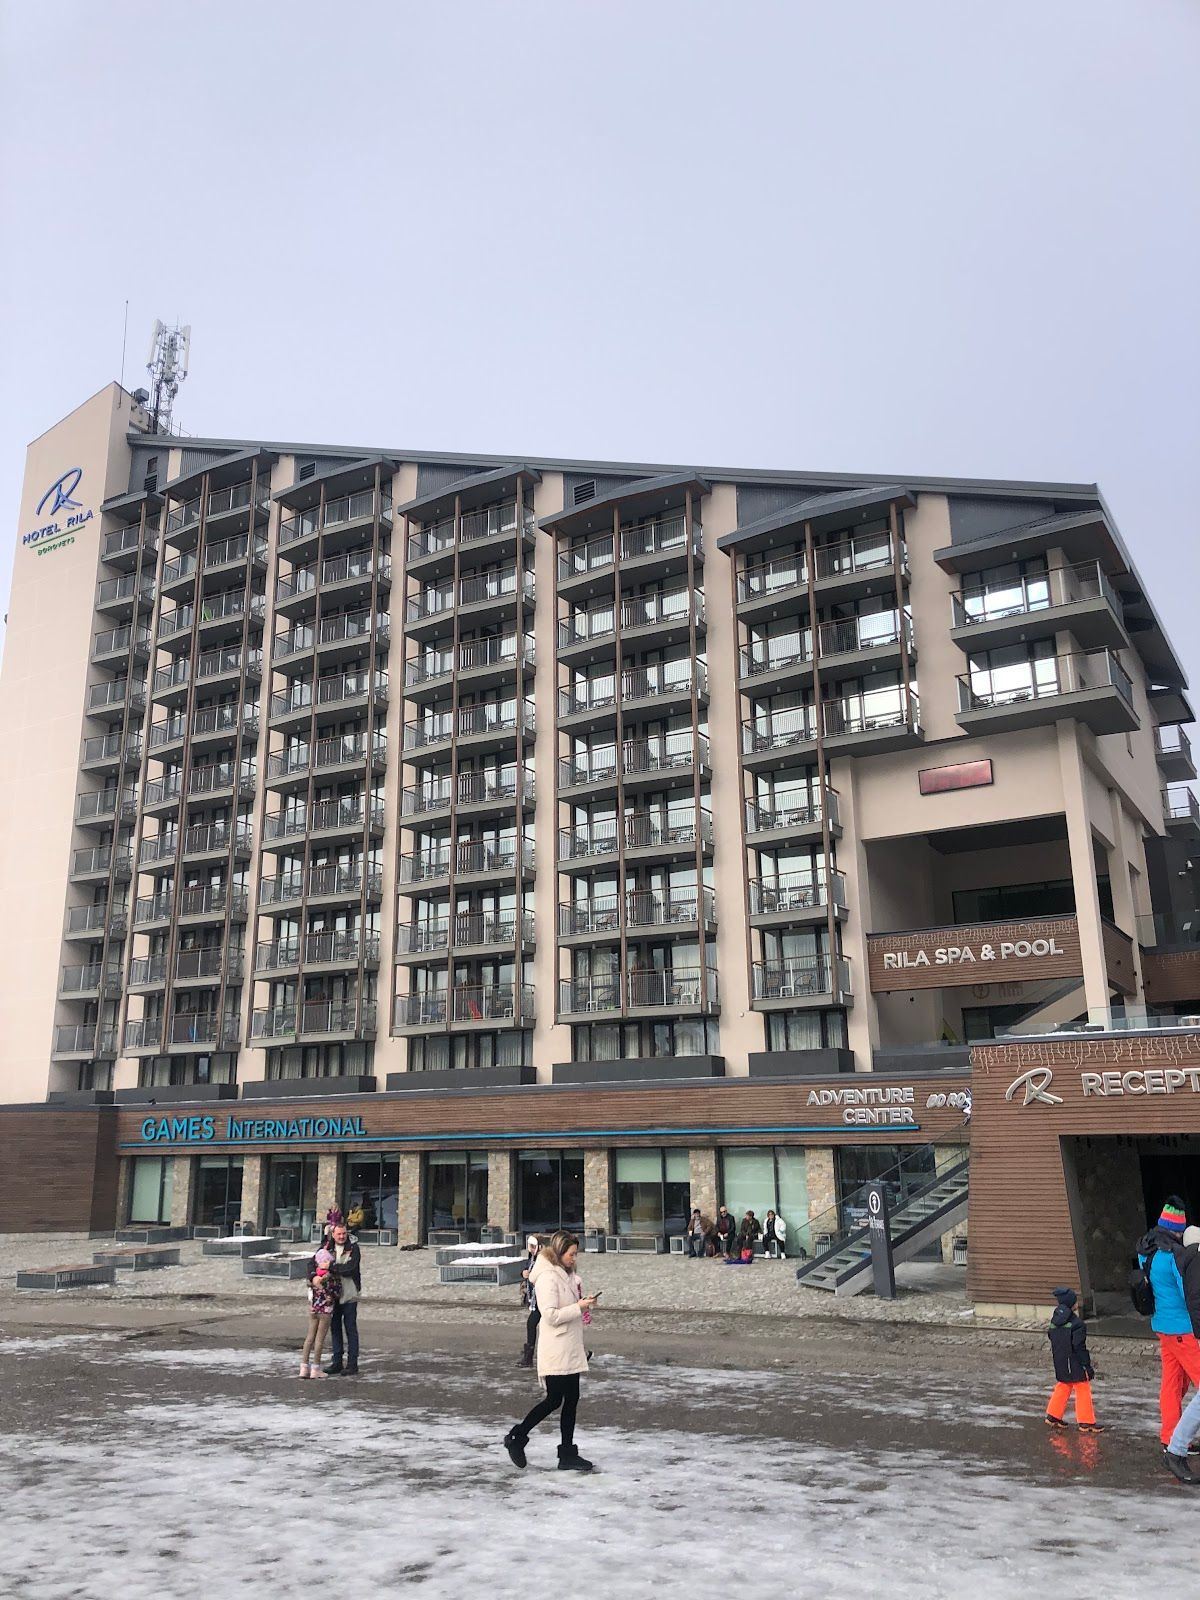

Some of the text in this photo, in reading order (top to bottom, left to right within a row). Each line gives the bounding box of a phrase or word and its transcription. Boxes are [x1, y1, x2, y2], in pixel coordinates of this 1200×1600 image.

[22, 509, 94, 545] HOTEL RILA
[883, 938, 1064, 970] RILA SPA & POOL
[806, 1087, 915, 1106] ADVENTURE
[141, 1115, 367, 1141] GAMES INTERNATIONAL
[842, 1107, 915, 1124] CENTER
